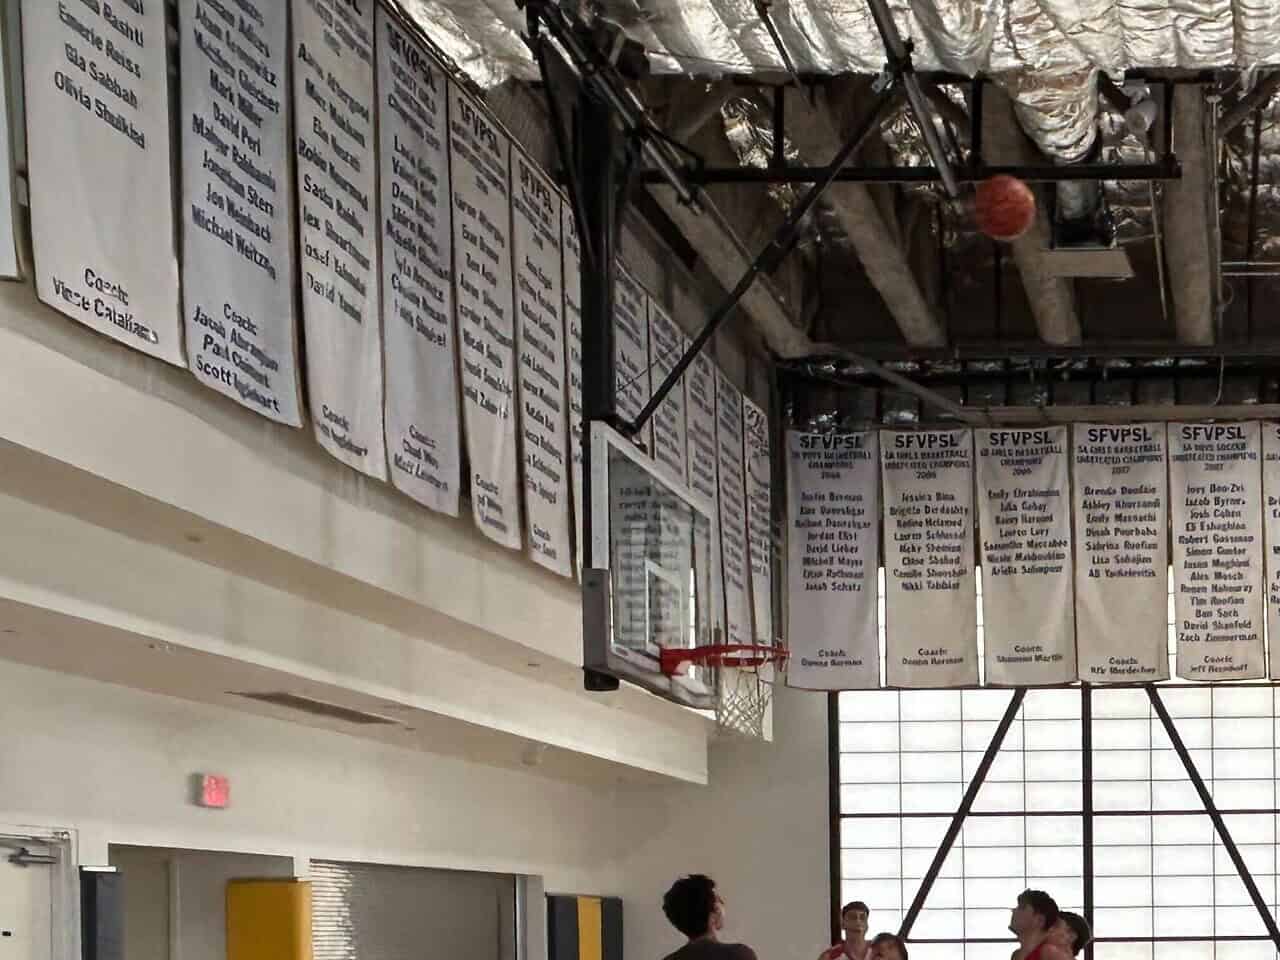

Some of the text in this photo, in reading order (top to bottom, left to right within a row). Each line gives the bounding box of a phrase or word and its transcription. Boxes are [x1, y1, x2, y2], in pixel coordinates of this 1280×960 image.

[990, 431, 1052, 448] SFVPSL
[1088, 428, 1152, 442] SFVPSL
[1182, 424, 1246, 440] SFVPSL
[800, 434, 862, 449] SFVPSL
[896, 434, 958, 448] SFVPSL
